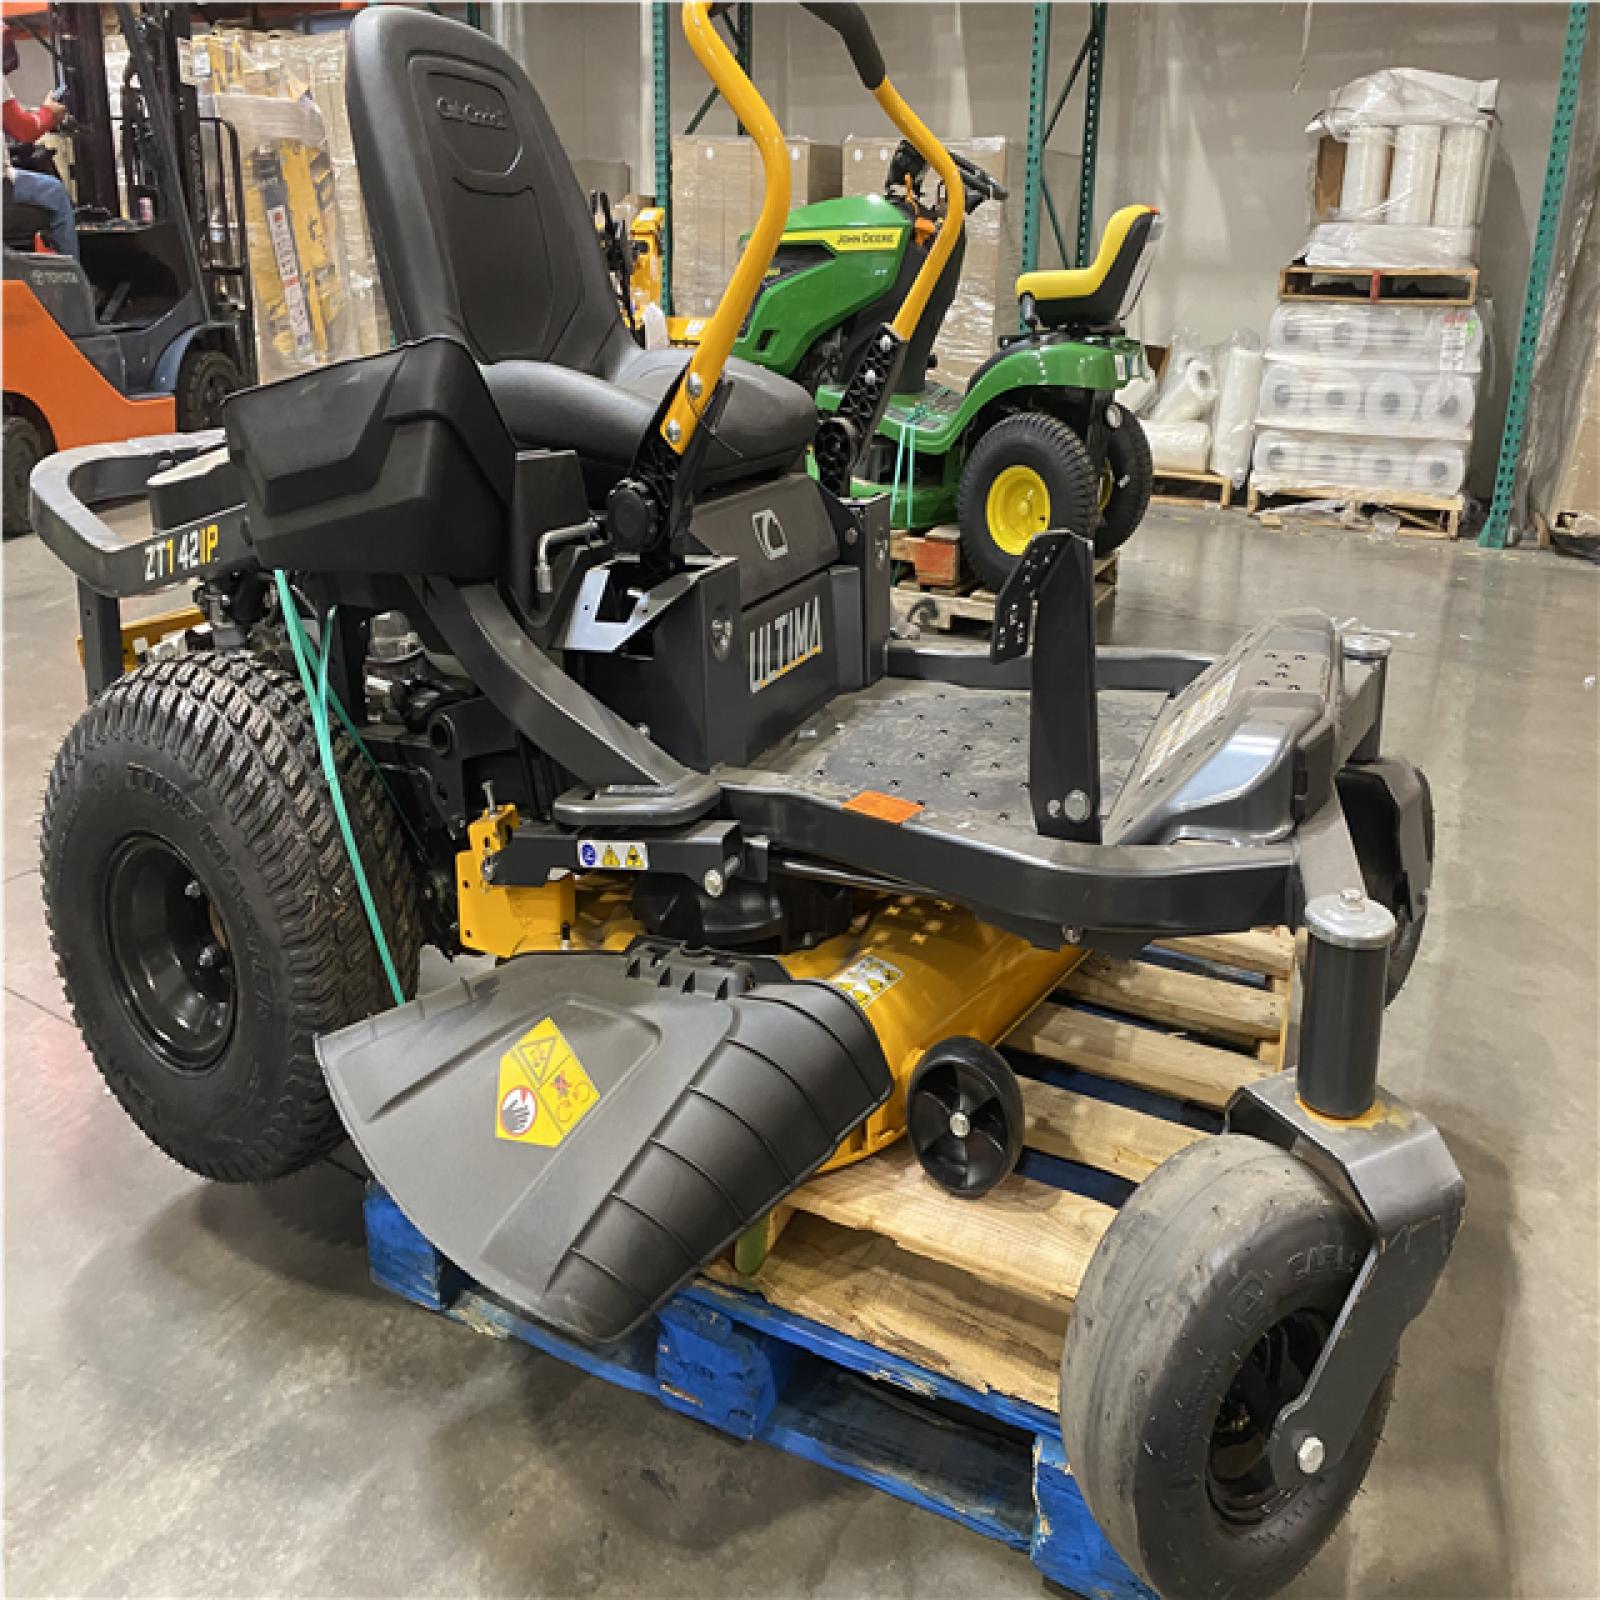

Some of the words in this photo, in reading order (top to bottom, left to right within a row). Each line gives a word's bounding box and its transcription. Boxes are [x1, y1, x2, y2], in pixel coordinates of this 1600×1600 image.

[862, 233, 893, 243] DEERE
[44, 271, 78, 284] TOYOTA
[144, 538, 174, 581] ZT1
[749, 594, 823, 694] ULTIMA
